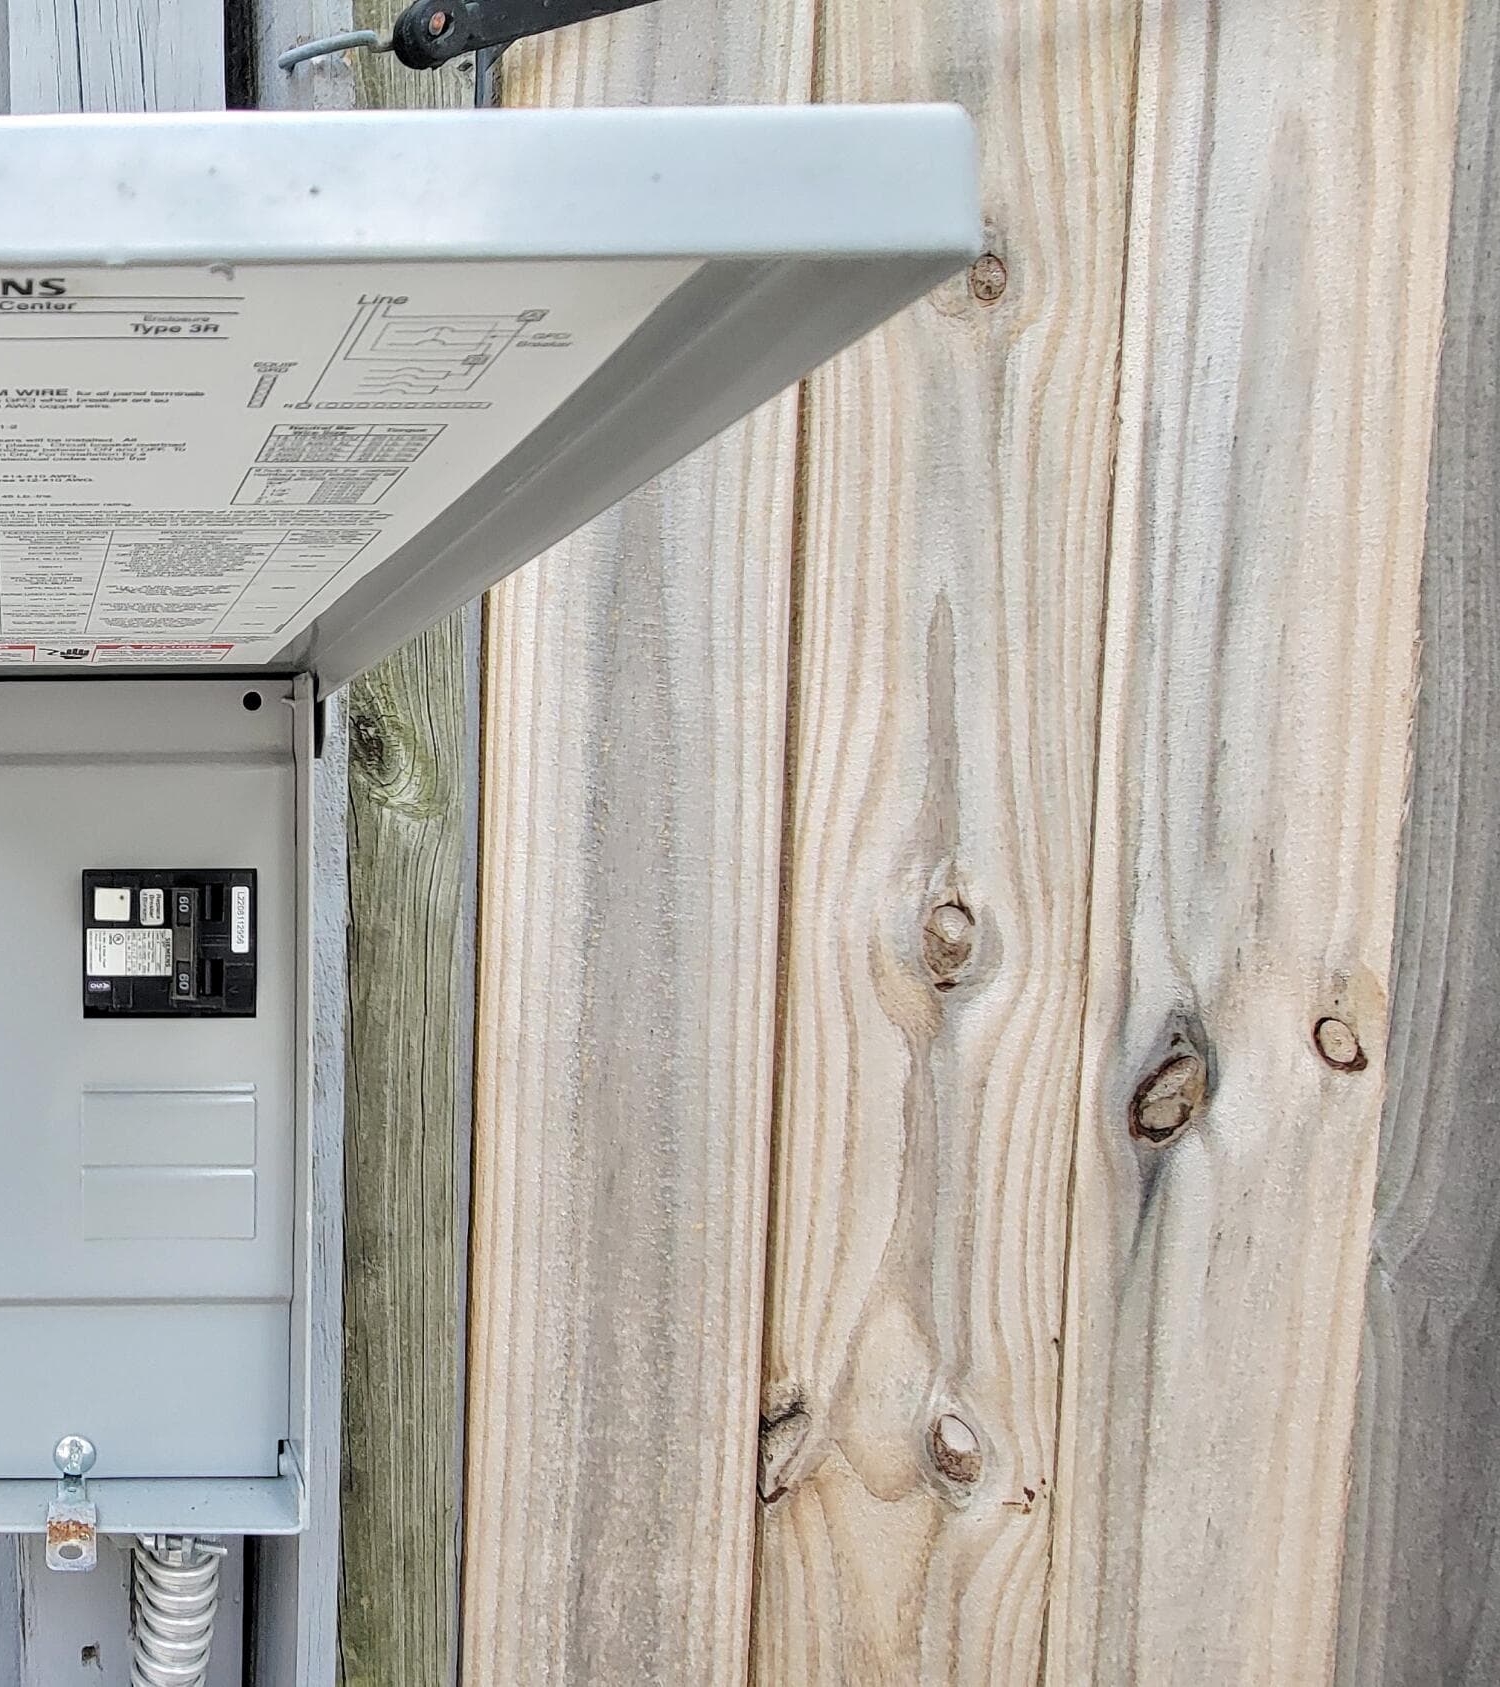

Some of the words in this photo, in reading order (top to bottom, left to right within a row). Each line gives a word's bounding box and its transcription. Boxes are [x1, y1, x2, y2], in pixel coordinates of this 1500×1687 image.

[357, 294, 409, 306] Line
[130, 323, 181, 335] Type
[188, 323, 221, 333] 3R
[15, 388, 69, 397] WIRE
[179, 896, 189, 913] 60
[179, 973, 189, 990] 60
